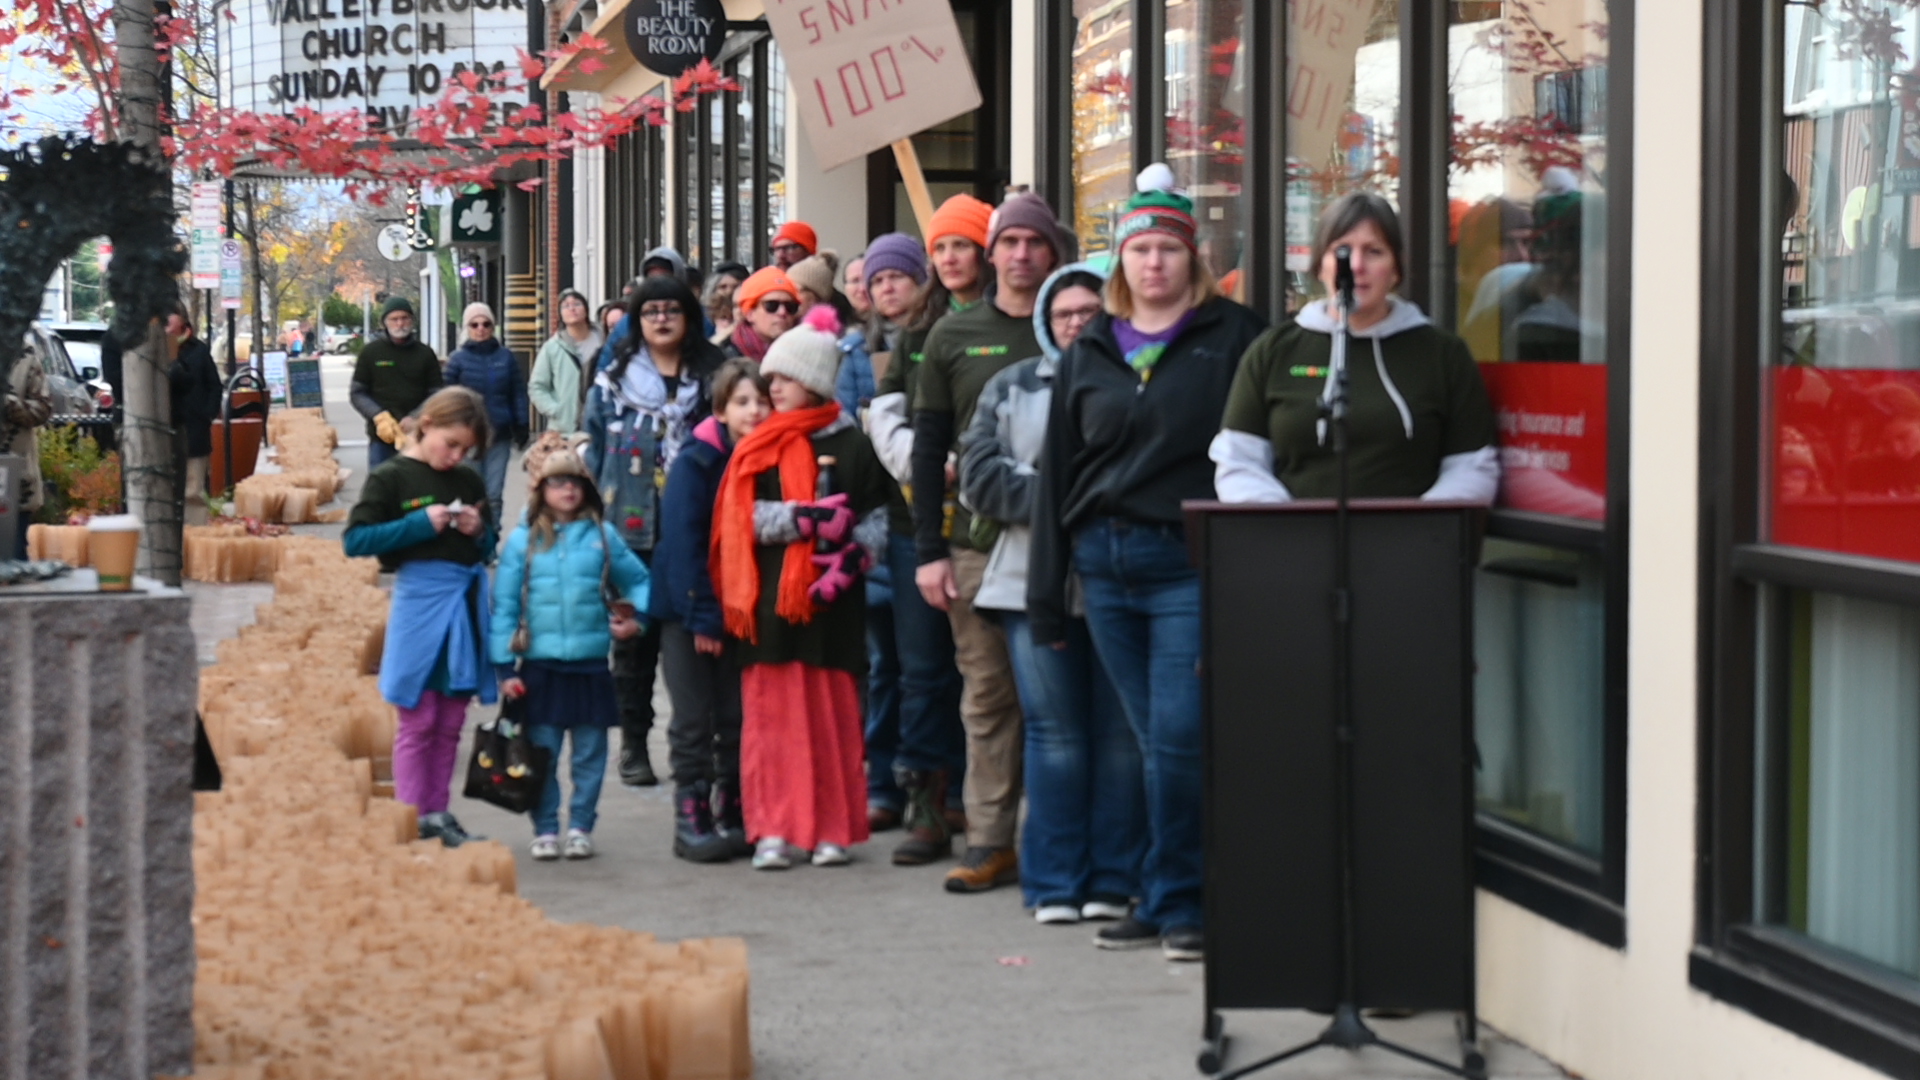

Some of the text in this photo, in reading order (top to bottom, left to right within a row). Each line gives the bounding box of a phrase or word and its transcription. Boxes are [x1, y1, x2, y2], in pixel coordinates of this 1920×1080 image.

[637, 16, 716, 37] BEAUTY
[656, 0, 696, 18] THE
[799, 0, 905, 45] SNA
[301, 22, 446, 61] CHURCH
[647, 35, 706, 56] ROOM
[268, 65, 387, 105] SUNDAY
[408, 62, 441, 96] 10
[813, 33, 945, 128] 100%
